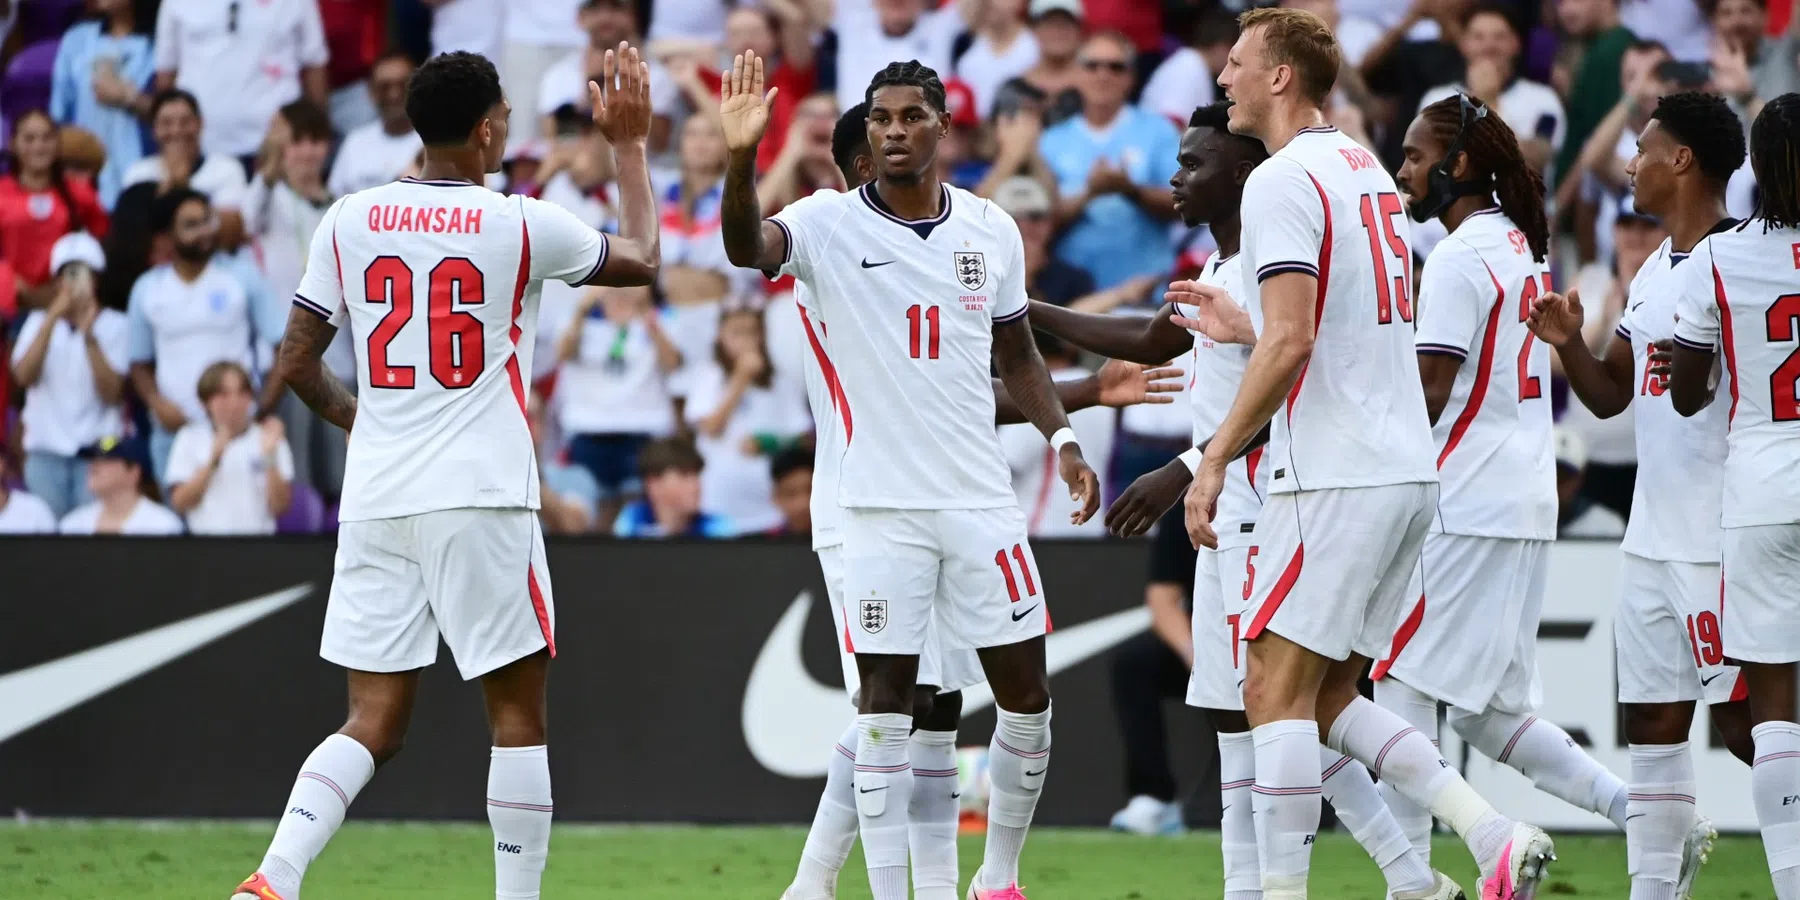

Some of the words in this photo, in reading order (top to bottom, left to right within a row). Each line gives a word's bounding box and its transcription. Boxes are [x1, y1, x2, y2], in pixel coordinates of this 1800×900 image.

[368, 204, 482, 234] QUANSAH
[1360, 192, 1412, 325] 15
[364, 255, 485, 389] 26
[906, 304, 940, 359] 11
[994, 543, 1037, 603] 11
[1687, 610, 1723, 669] 19
[289, 806, 317, 821] ENG
[1782, 795, 1800, 806] EN
[497, 841, 522, 854] ENG
